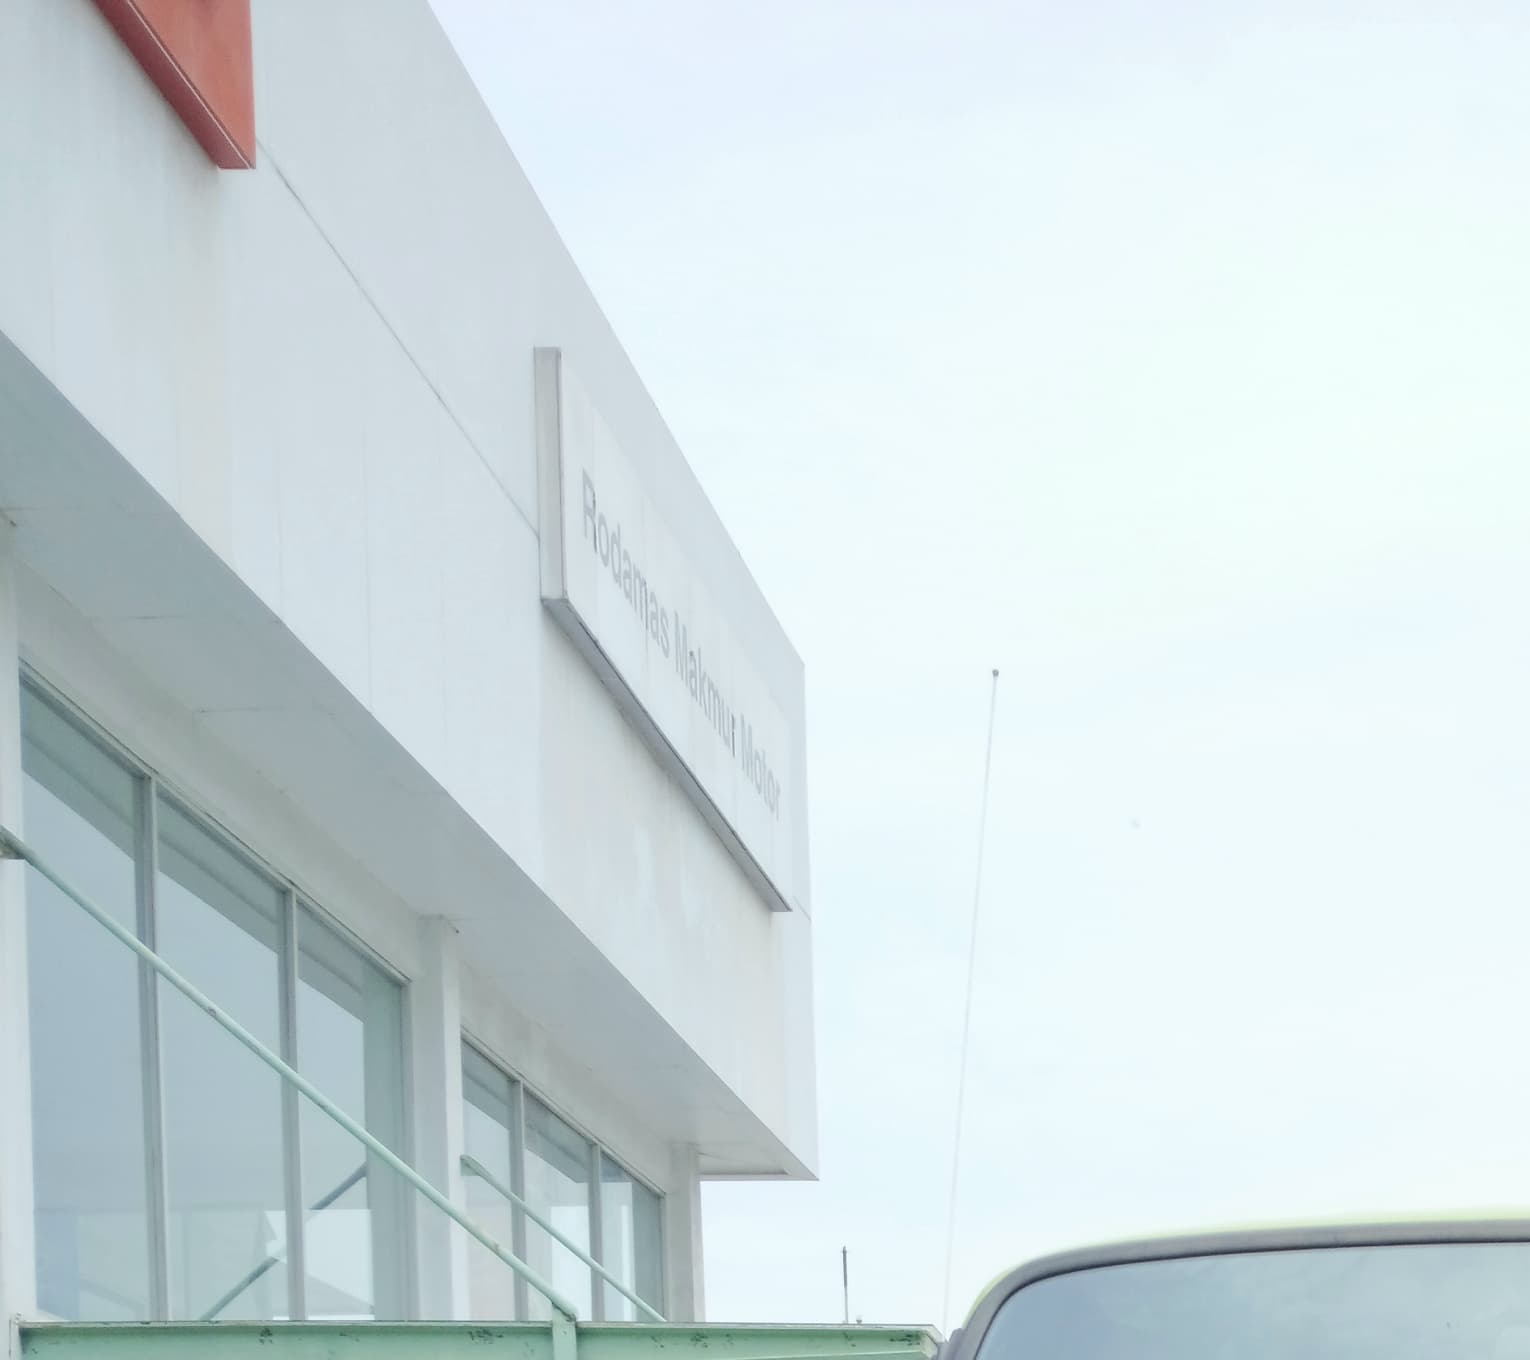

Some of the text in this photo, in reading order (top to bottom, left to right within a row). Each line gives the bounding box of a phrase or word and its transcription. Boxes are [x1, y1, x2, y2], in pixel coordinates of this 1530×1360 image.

[581, 466, 781, 822] Rodamas Makmur Motor
